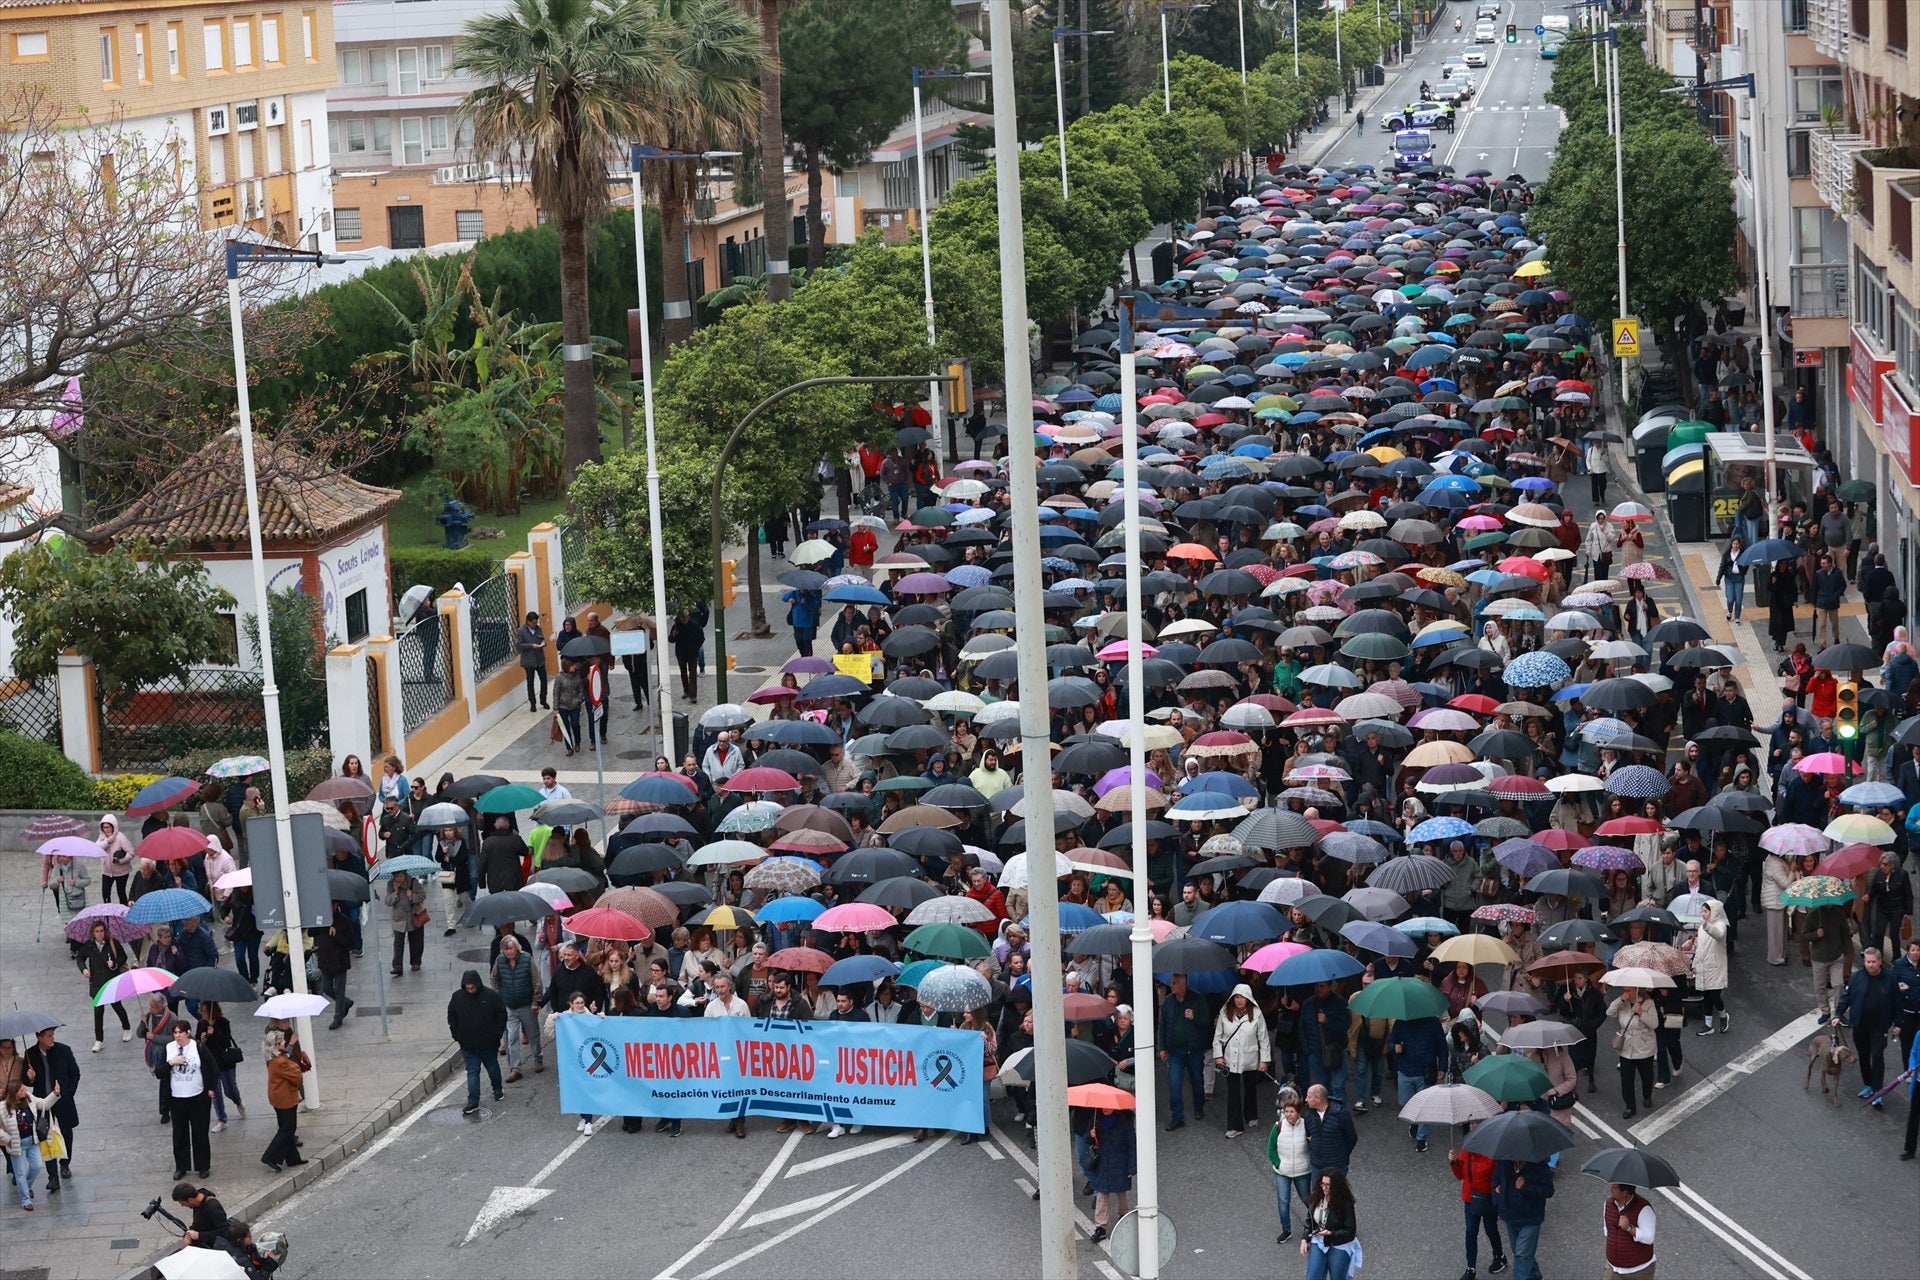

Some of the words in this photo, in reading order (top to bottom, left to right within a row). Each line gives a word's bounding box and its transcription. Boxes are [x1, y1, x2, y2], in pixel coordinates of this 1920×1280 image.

[337, 555, 358, 575] Scouts
[360, 541, 379, 564] Loyola
[624, 1041, 720, 1080] MEMORIA
[736, 1039, 815, 1081] VERDAD
[835, 1046, 917, 1087] JUSTICIA
[651, 1088, 709, 1099] Asociación
[711, 1087, 757, 1099] Víctimas
[760, 1087, 850, 1104] Descarrilamiento
[853, 1096, 896, 1106] Adamuz
